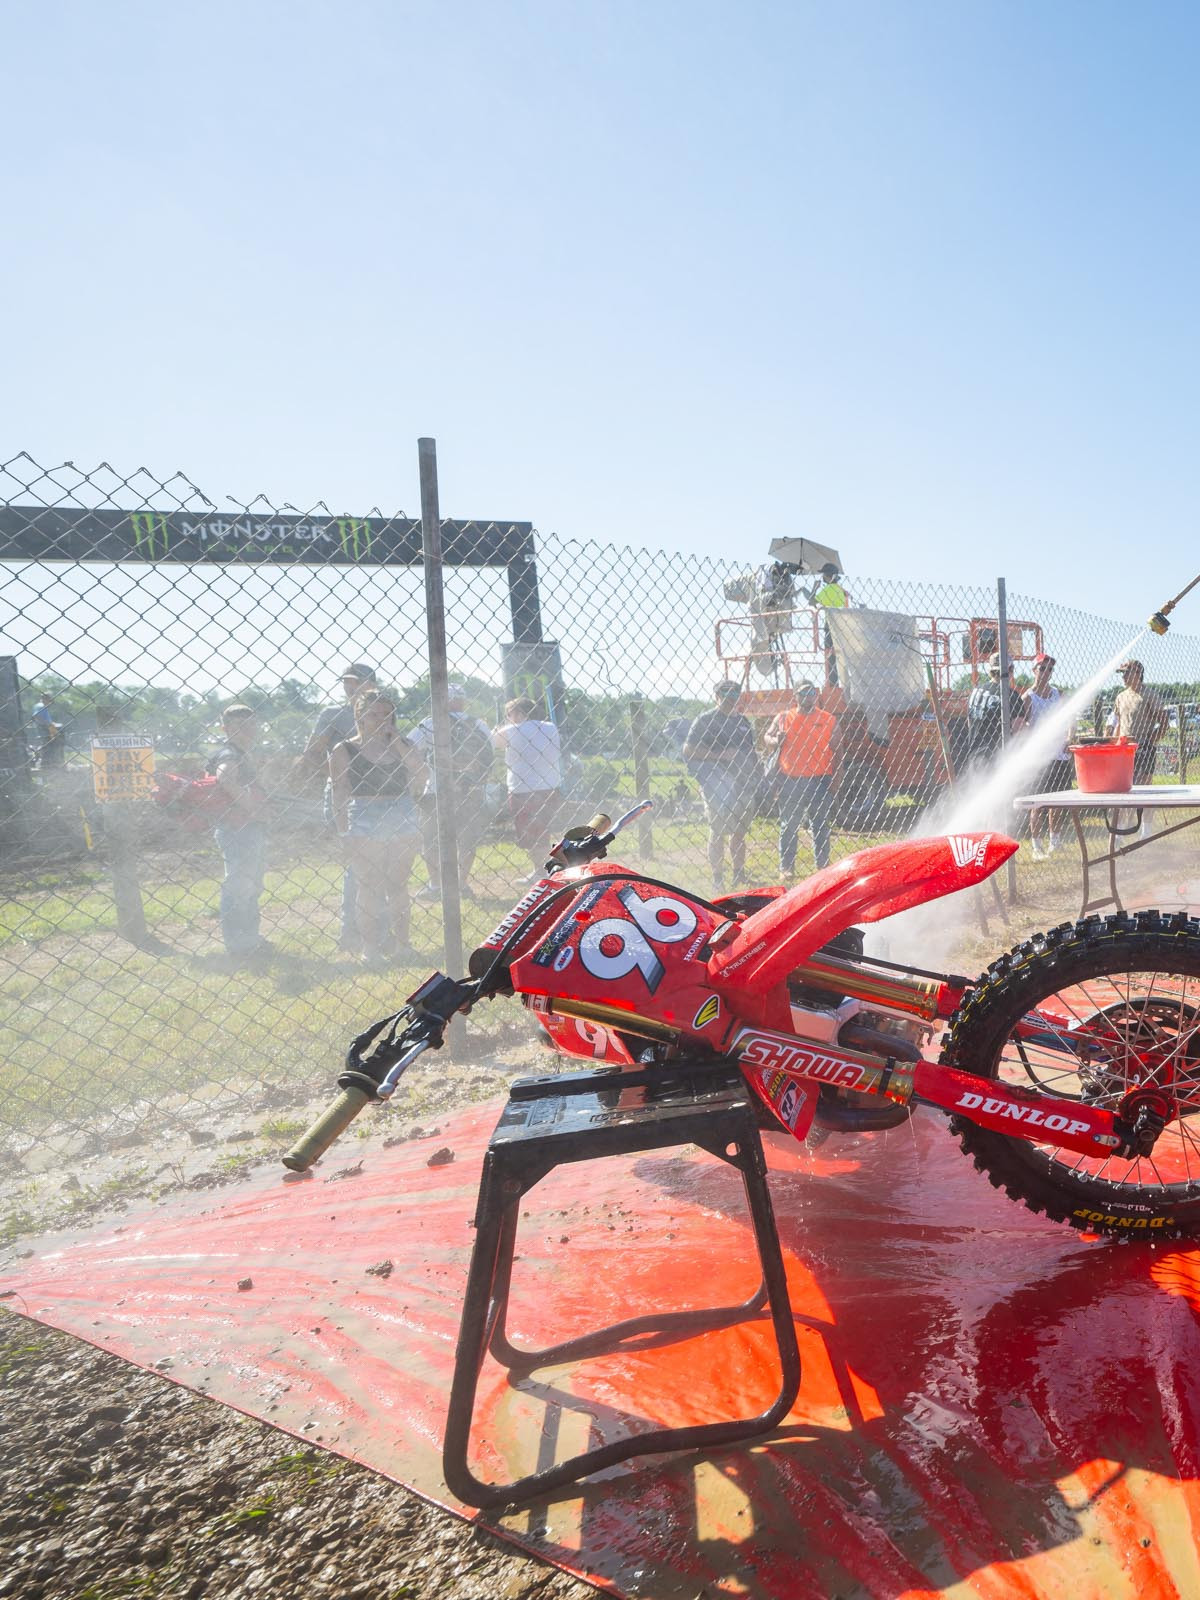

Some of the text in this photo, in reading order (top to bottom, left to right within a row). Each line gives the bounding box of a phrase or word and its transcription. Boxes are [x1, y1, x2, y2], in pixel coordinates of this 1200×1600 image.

[181, 519, 333, 543] MONSTER
[487, 884, 549, 946] RENTHAL
[578, 883, 698, 997] 96
[683, 931, 707, 962] HONDA
[730, 941, 767, 970] TRUETIMBER
[738, 1038, 865, 1088] SHOWA
[955, 1092, 1091, 1135] DUNLOP
[1073, 1208, 1166, 1229] DUNLOP
